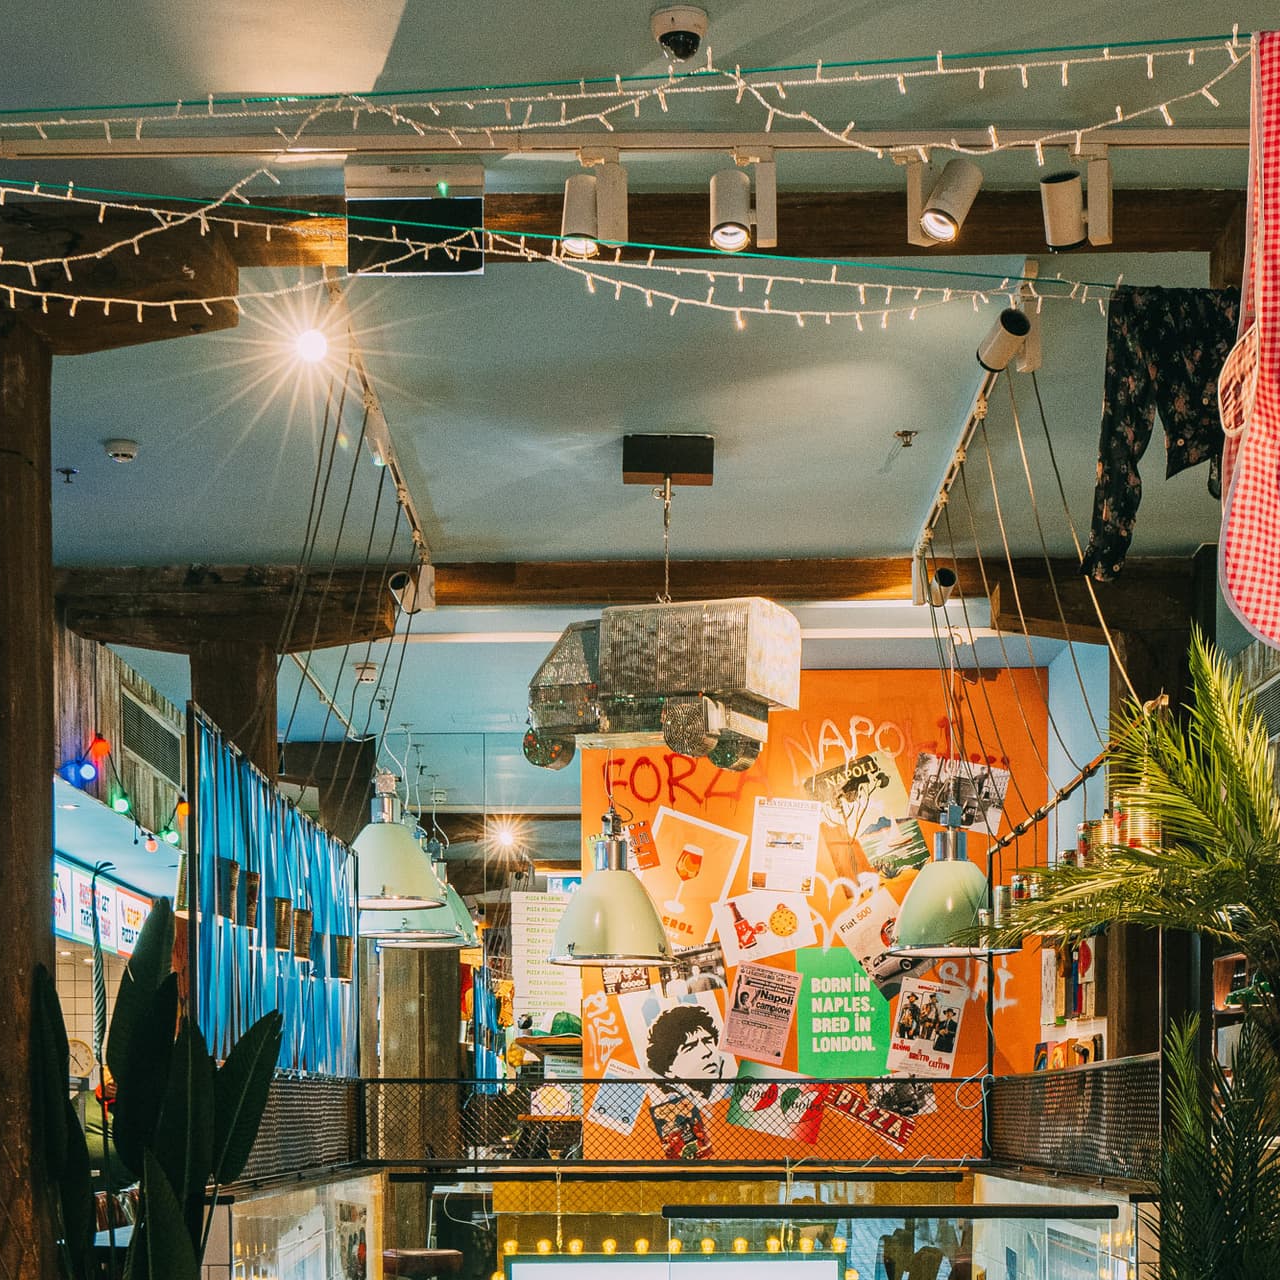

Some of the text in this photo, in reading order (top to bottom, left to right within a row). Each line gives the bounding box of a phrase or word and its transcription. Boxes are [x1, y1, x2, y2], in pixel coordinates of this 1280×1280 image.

[824, 760, 877, 789] NAPOLI
[662, 915, 695, 935] EROL
[840, 906, 873, 934] Fiat 500
[811, 977, 851, 993] BORN
[760, 990, 794, 1005] Napoli
[811, 997, 875, 1013] NAPLES.
[756, 1001, 791, 1016] campione
[812, 1017, 850, 1033] BRED
[812, 1036, 876, 1053] LONDON.
[835, 1089, 903, 1138] PIZZA
